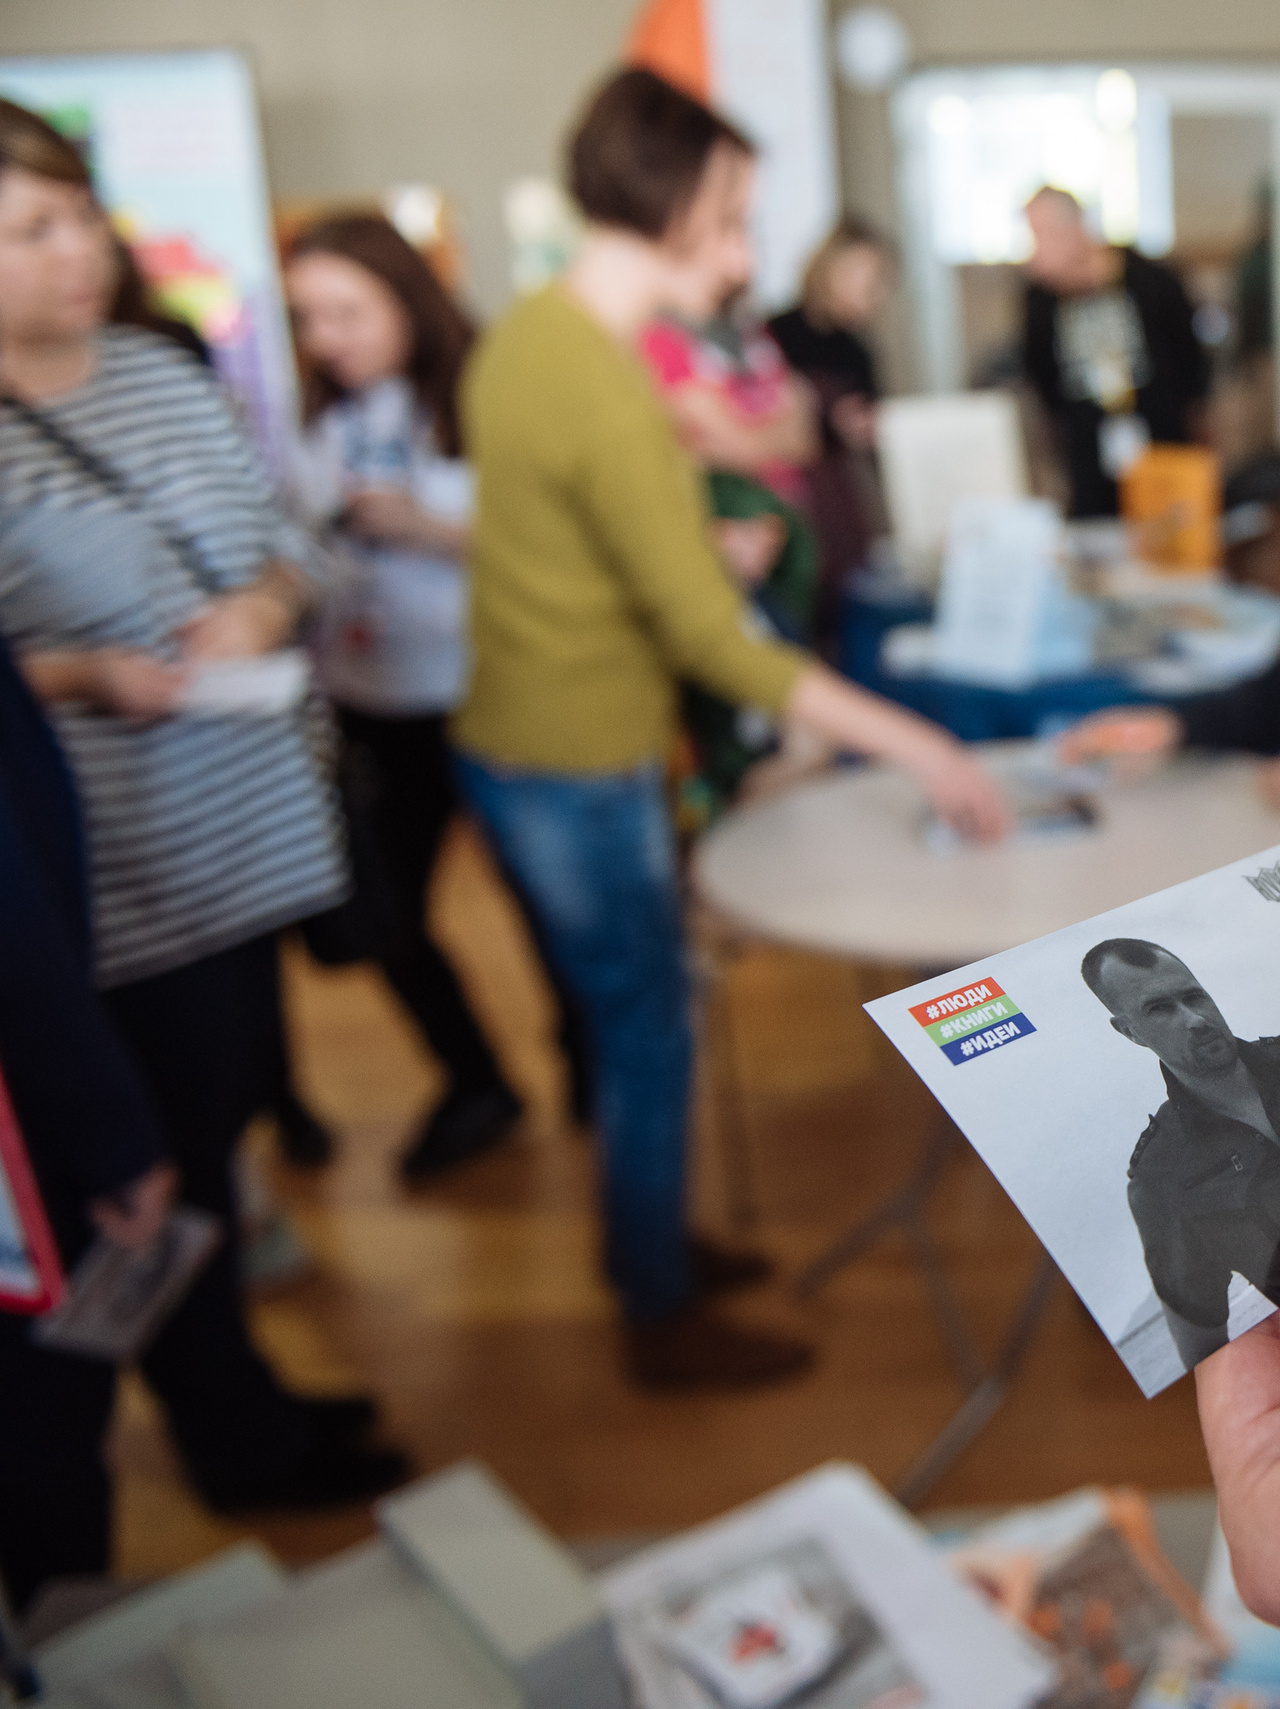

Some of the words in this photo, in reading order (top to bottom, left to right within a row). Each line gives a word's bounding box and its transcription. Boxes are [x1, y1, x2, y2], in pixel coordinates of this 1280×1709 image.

[925, 984, 993, 1020] #ЛЮДИ
[940, 1001, 1009, 1039] #КНИГИ
[960, 1021, 1021, 1057] #ИДЕИ
